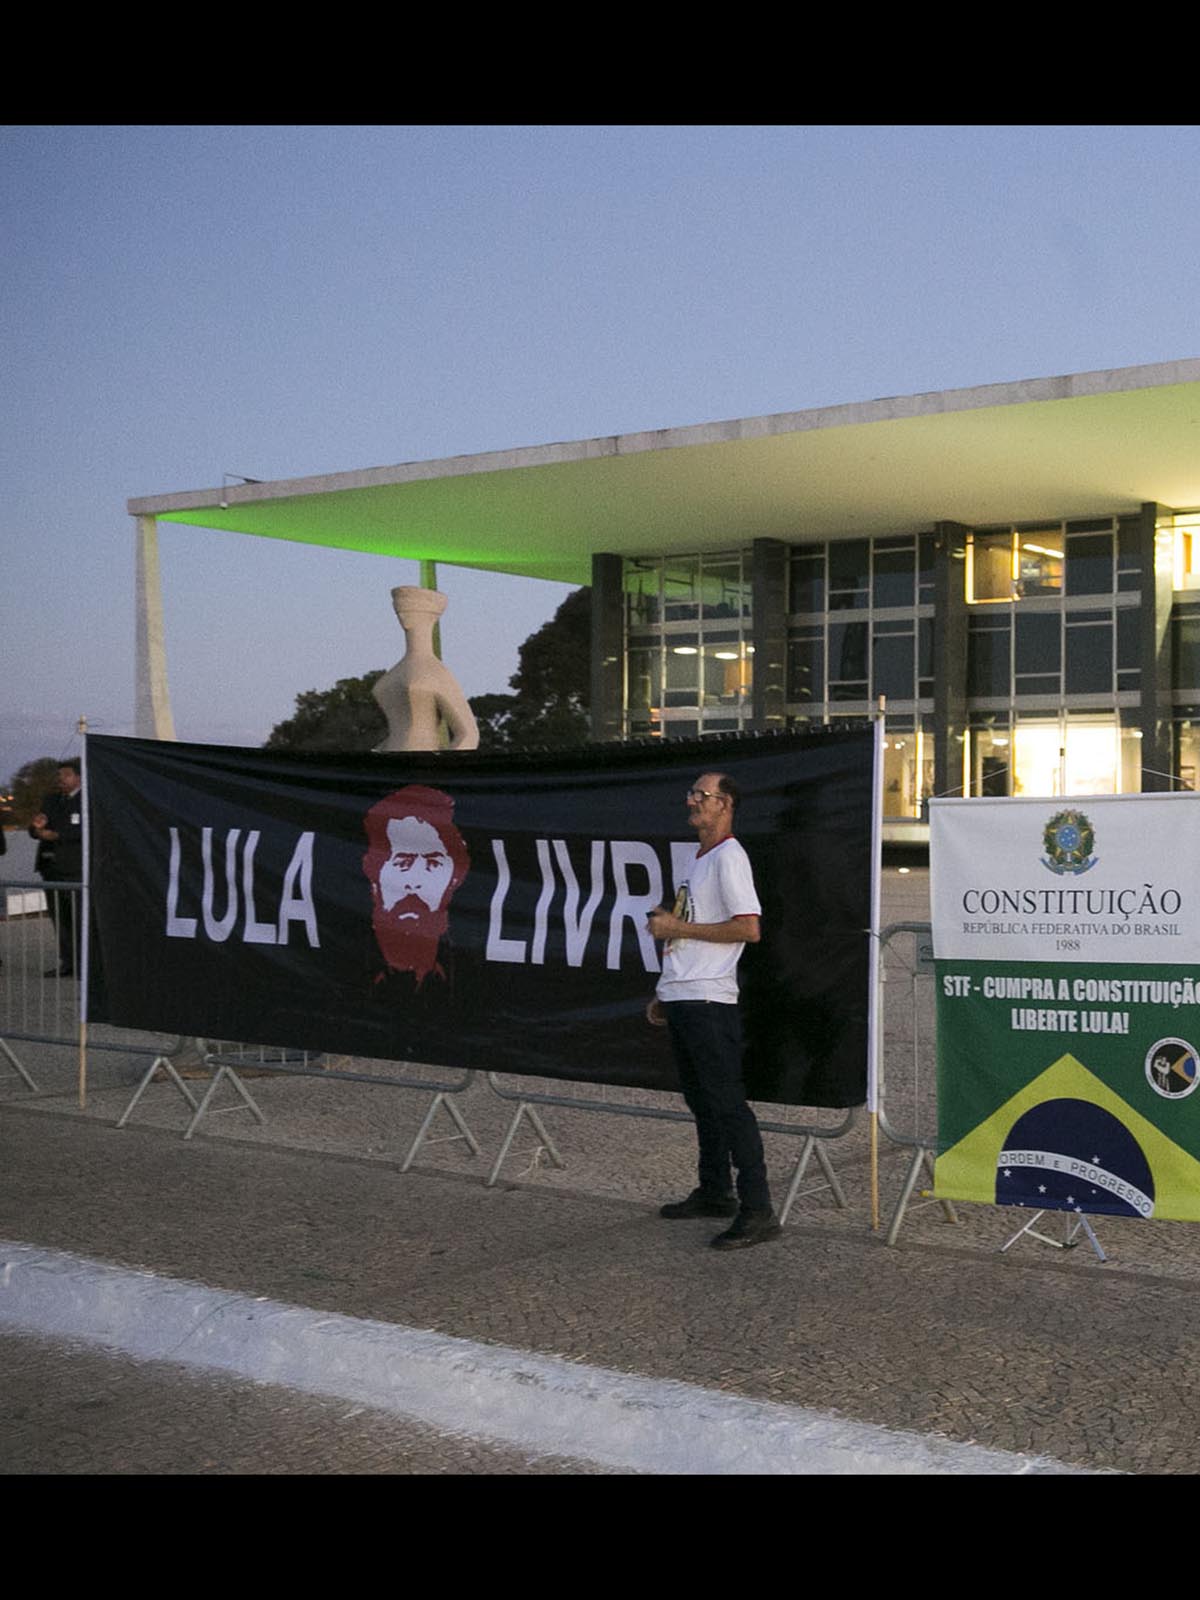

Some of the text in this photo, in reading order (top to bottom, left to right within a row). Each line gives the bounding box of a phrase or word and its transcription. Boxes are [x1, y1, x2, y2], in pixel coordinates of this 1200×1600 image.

[166, 827, 320, 948] LULA
[963, 883, 1182, 921] CONSTITUIÇÃO
[963, 920, 1182, 936] REPÚBLICA FEDERATIVA DO BRASIL
[1056, 939, 1080, 951] 1988
[943, 975, 971, 997] STF
[983, 976, 1057, 1000] CUMPRA
[1057, 979, 1070, 1000] A
[1011, 1008, 1129, 1034] LIBERTE LULA!
[999, 1152, 1152, 1214] ORDEM E PROGRESSO
